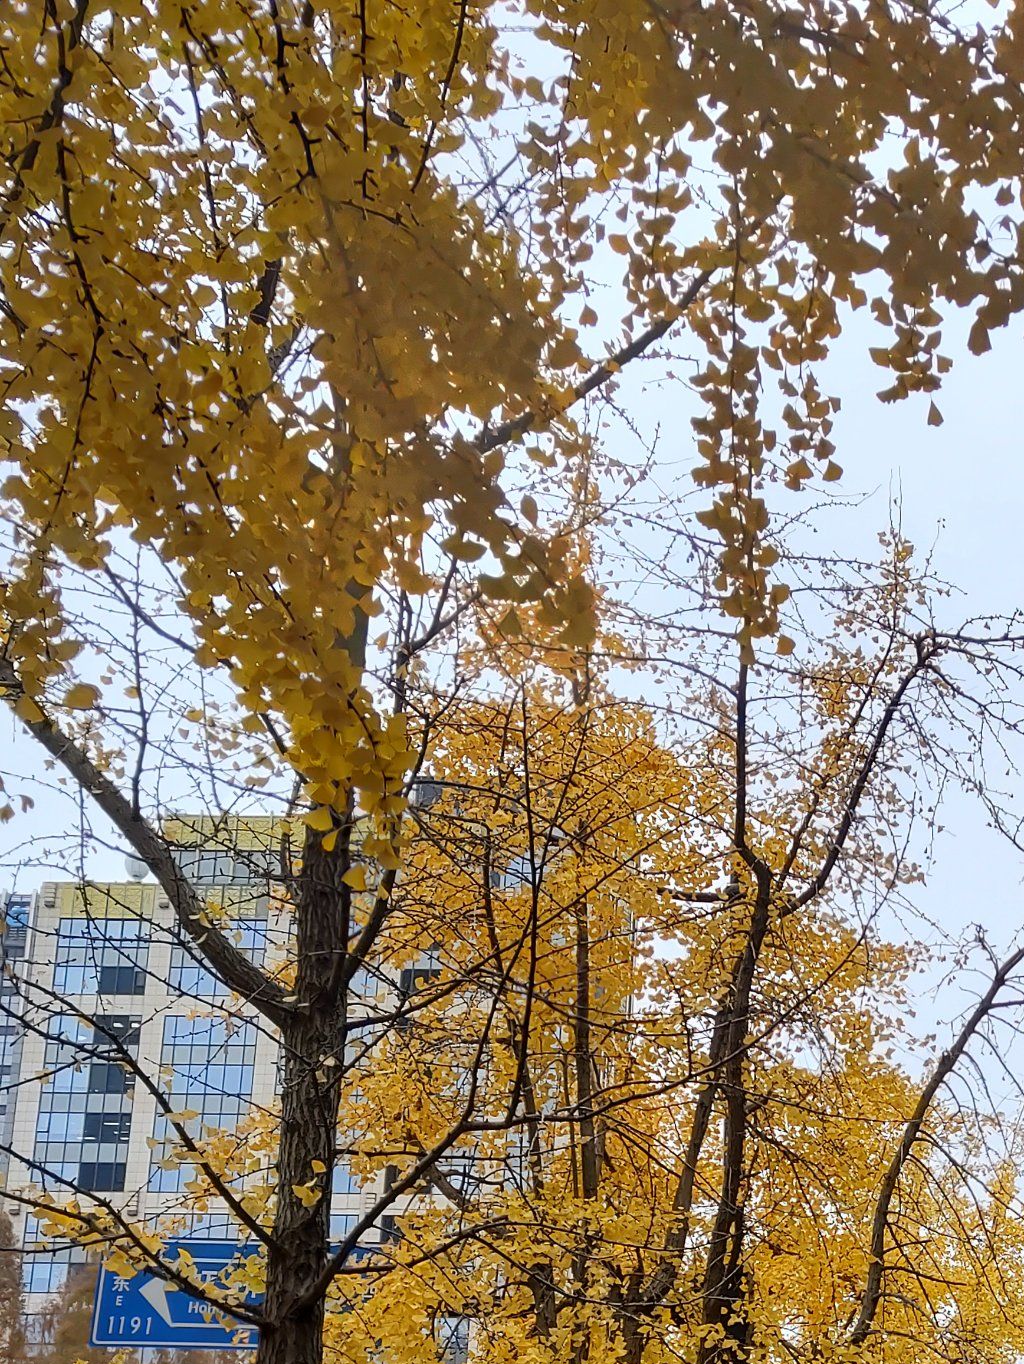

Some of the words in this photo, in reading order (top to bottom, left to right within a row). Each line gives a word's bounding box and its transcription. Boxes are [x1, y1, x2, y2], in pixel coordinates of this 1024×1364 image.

[111, 1275, 131, 1292] 东
[115, 1295, 123, 1307] E
[107, 1315, 152, 1335] 1191
